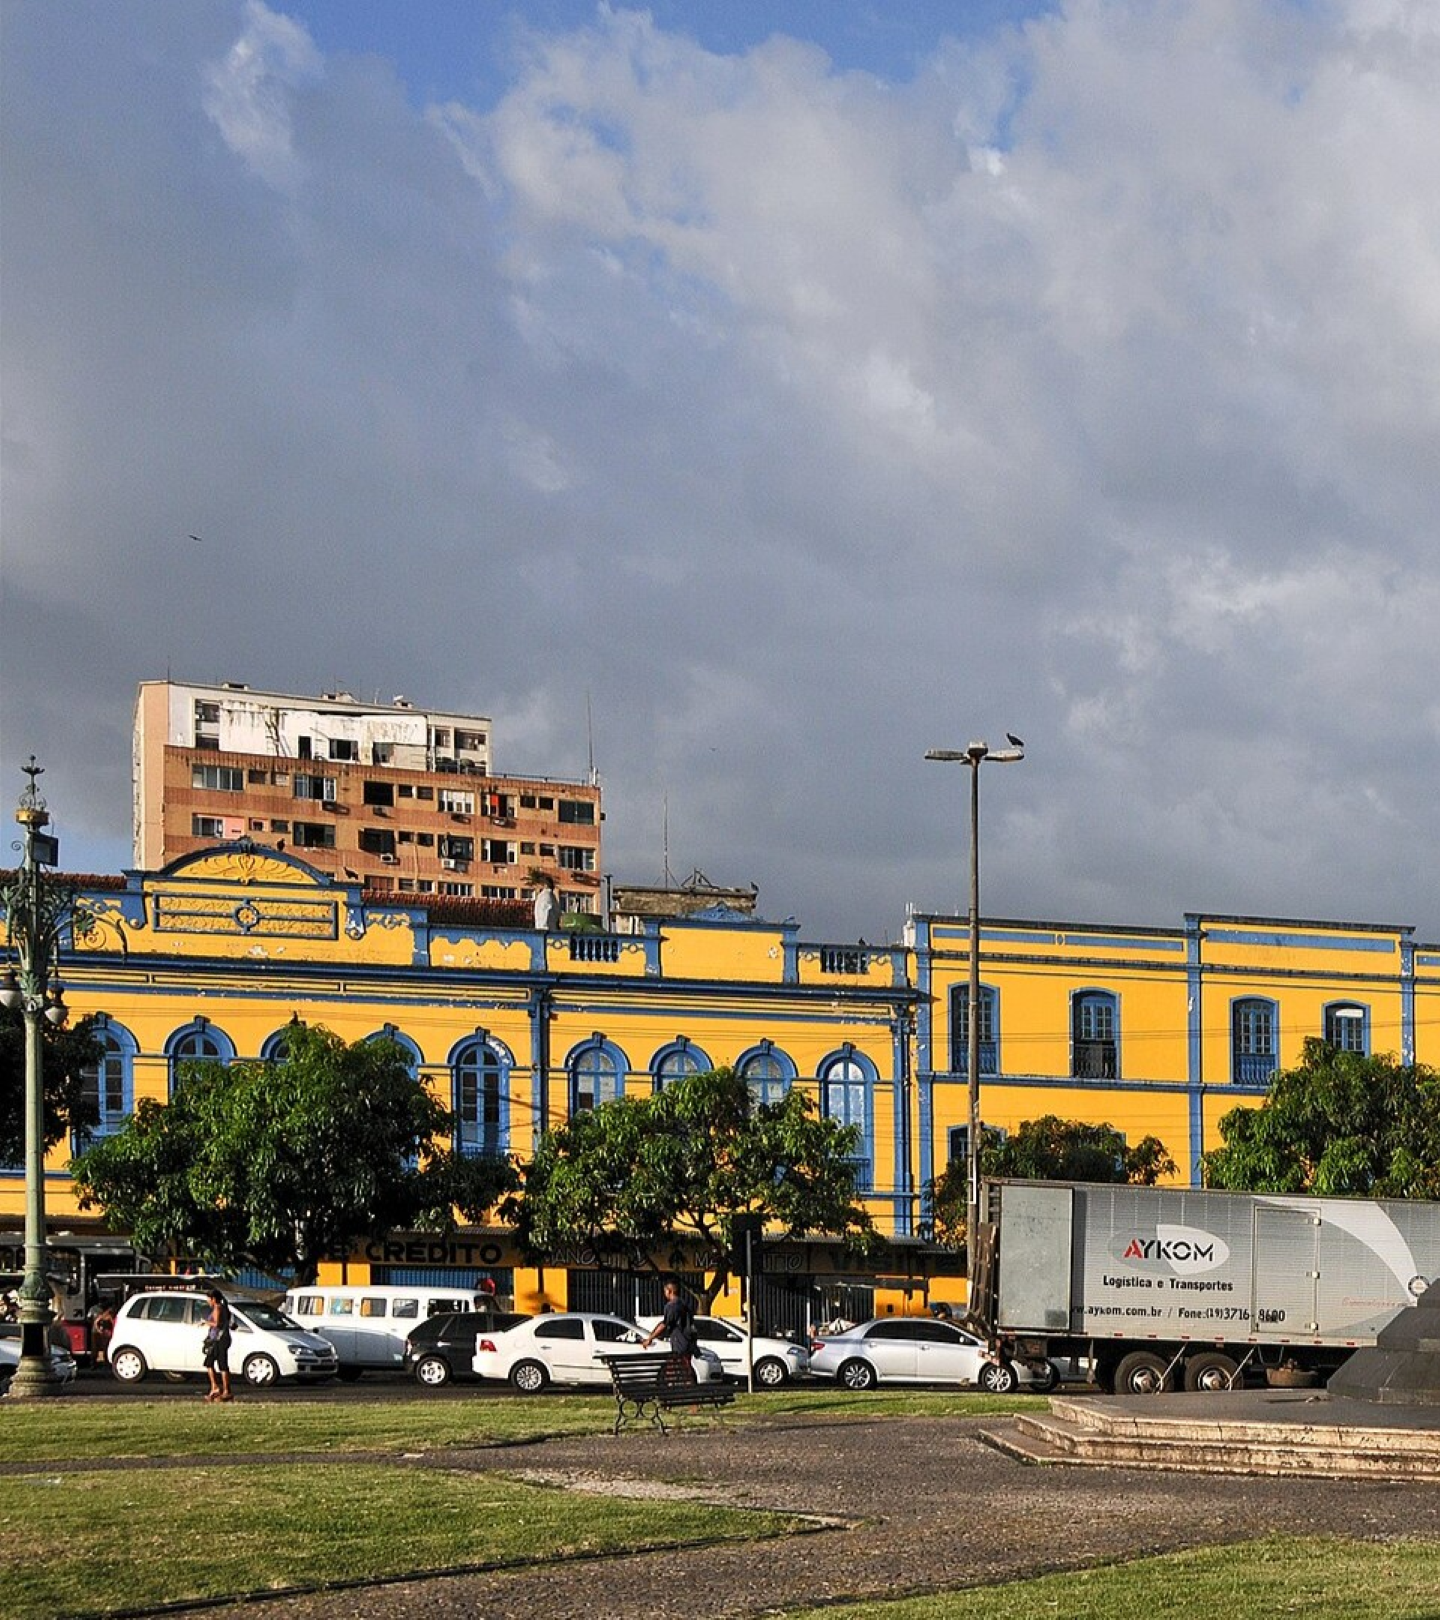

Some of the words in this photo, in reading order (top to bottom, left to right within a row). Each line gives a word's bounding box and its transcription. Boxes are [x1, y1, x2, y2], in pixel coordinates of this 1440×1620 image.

[1124, 1238, 1214, 1262] AYKOM
[1157, 1280, 1164, 1288] e
[1169, 1278, 1233, 1292] Transportes
